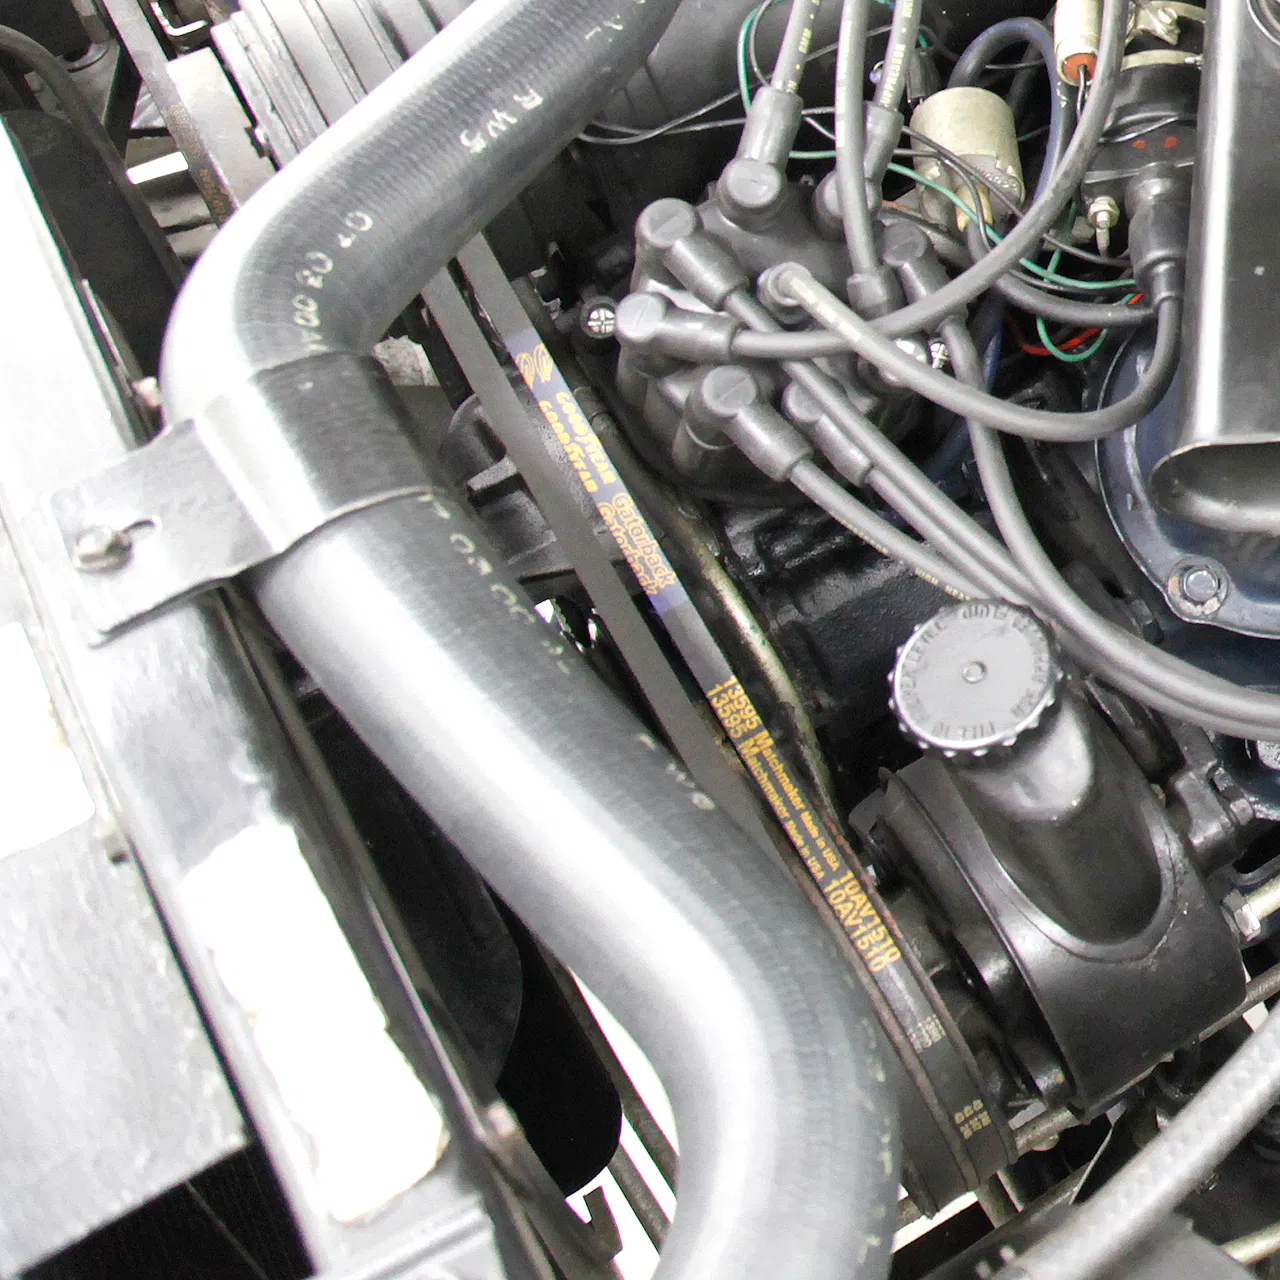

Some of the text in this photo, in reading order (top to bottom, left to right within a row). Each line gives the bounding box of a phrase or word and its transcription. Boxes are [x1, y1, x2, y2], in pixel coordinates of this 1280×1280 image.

[878, 41, 906, 108] UPPRESSOR
[550, 386, 621, 489] GOODYEAR
[607, 488, 679, 591] Gatorback
[702, 681, 749, 741] 13595
[736, 736, 796, 822] Matchmaker
[803, 855, 825, 881] USA
[719, 673, 763, 732] 13595
[751, 728, 811, 814] Matchmaker
[819, 846, 841, 873] USA
[818, 877, 890, 975] 10AV1510
[834, 868, 904, 965] 10AV1510
